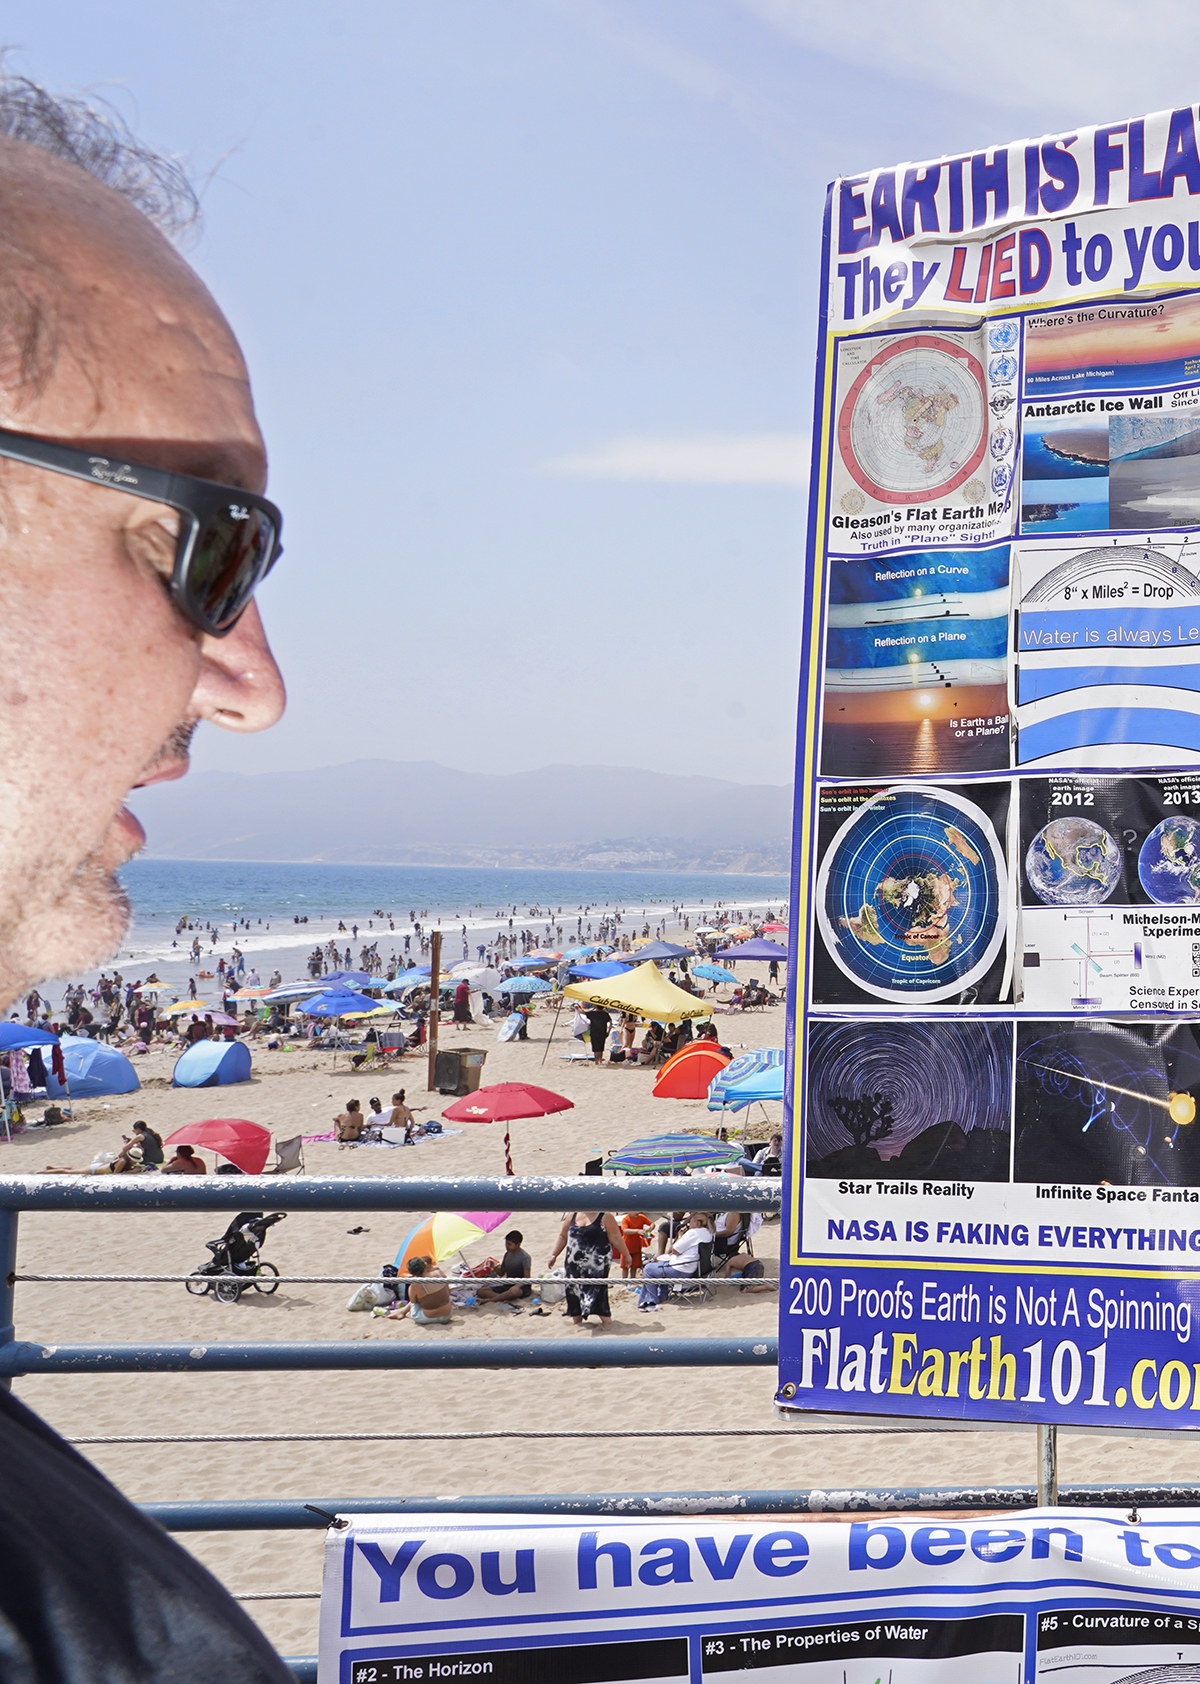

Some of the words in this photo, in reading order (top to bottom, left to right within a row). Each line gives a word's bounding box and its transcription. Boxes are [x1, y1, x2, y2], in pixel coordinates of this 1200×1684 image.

[838, 150, 1010, 254] EARTH
[1024, 136, 1080, 217] IS
[837, 258, 940, 320] They
[944, 228, 1052, 303] LIED
[1062, 222, 1112, 286] to
[1028, 314, 1074, 329] Where's
[1077, 311, 1094, 322] the
[1098, 305, 1165, 320] Curvature?
[1086, 370, 1115, 378] Michigan!
[1171, 398, 1198, 408] Since
[1173, 391, 1190, 399] Off
[1025, 400, 1095, 417] Antarctic
[1100, 399, 1124, 412] Ice
[1128, 396, 1163, 410] Wall
[832, 511, 901, 528] Gleason's
[907, 508, 937, 521] Flat
[943, 505, 984, 519] Earth
[988, 500, 1011, 515] Map
[850, 531, 872, 540] Also
[874, 526, 892, 537] used
[894, 525, 905, 535] by
[907, 523, 935, 533] many
[939, 519, 1001, 532] organization
[861, 540, 889, 551] Truth
[891, 537, 901, 545] in
[904, 534, 956, 543] "Plane"
[960, 530, 995, 544] Sight!
[875, 568, 915, 581] Reflection
[917, 568, 927, 576] on
[937, 565, 969, 575] Curve
[1082, 590, 1088, 599] x
[1132, 586, 1139, 594] =
[1143, 583, 1174, 600] Drop
[874, 634, 915, 647] Reflection
[918, 635, 928, 644] on
[938, 632, 966, 641] Plane
[1023, 629, 1079, 646] Water
[1085, 627, 1100, 642] is
[1106, 625, 1172, 646] always
[950, 719, 958, 728] Is
[961, 718, 985, 727] Earth
[994, 714, 1009, 724] Ball
[955, 729, 966, 737] or
[976, 725, 1005, 736] Plane?
[1051, 792, 1094, 806] 2012
[902, 954, 929, 962] Equator
[1129, 986, 1165, 996] Science
[589, 996, 609, 1006] Cub
[609, 1000, 643, 1014] Cadet
[1178, 999, 1187, 1009] in
[838, 1181, 873, 1195] Star
[876, 1181, 919, 1196] Trails
[922, 1183, 975, 1199] Reality
[1035, 1186, 1092, 1202] Infinite
[1096, 1187, 1147, 1204] Space
[827, 1219, 897, 1241] NASA
[905, 1221, 929, 1242] IS
[936, 1222, 1029, 1246] FAKING
[789, 1277, 833, 1317] 200
[841, 1278, 913, 1320] Proofs
[922, 1281, 980, 1323] Earth
[989, 1287, 1007, 1325] is
[1016, 1286, 1057, 1327] Not
[1063, 1288, 1080, 1327] A
[1087, 1288, 1191, 1344] Spinning
[355, 1540, 537, 1604] You
[578, 1531, 809, 1590] have
[848, 1523, 1083, 1572] been
[1041, 1616, 1059, 1632] #5
[1072, 1614, 1150, 1628] Curvature
[1154, 1617, 1170, 1628] of
[1174, 1620, 1183, 1629] a
[705, 1641, 725, 1655] #3
[740, 1638, 771, 1652] The
[776, 1630, 860, 1648] Properties
[865, 1626, 881, 1641] of
[884, 1625, 928, 1641] Water
[356, 1667, 377, 1683] #2
[393, 1665, 423, 1680] The
[428, 1660, 493, 1677] Horizon
